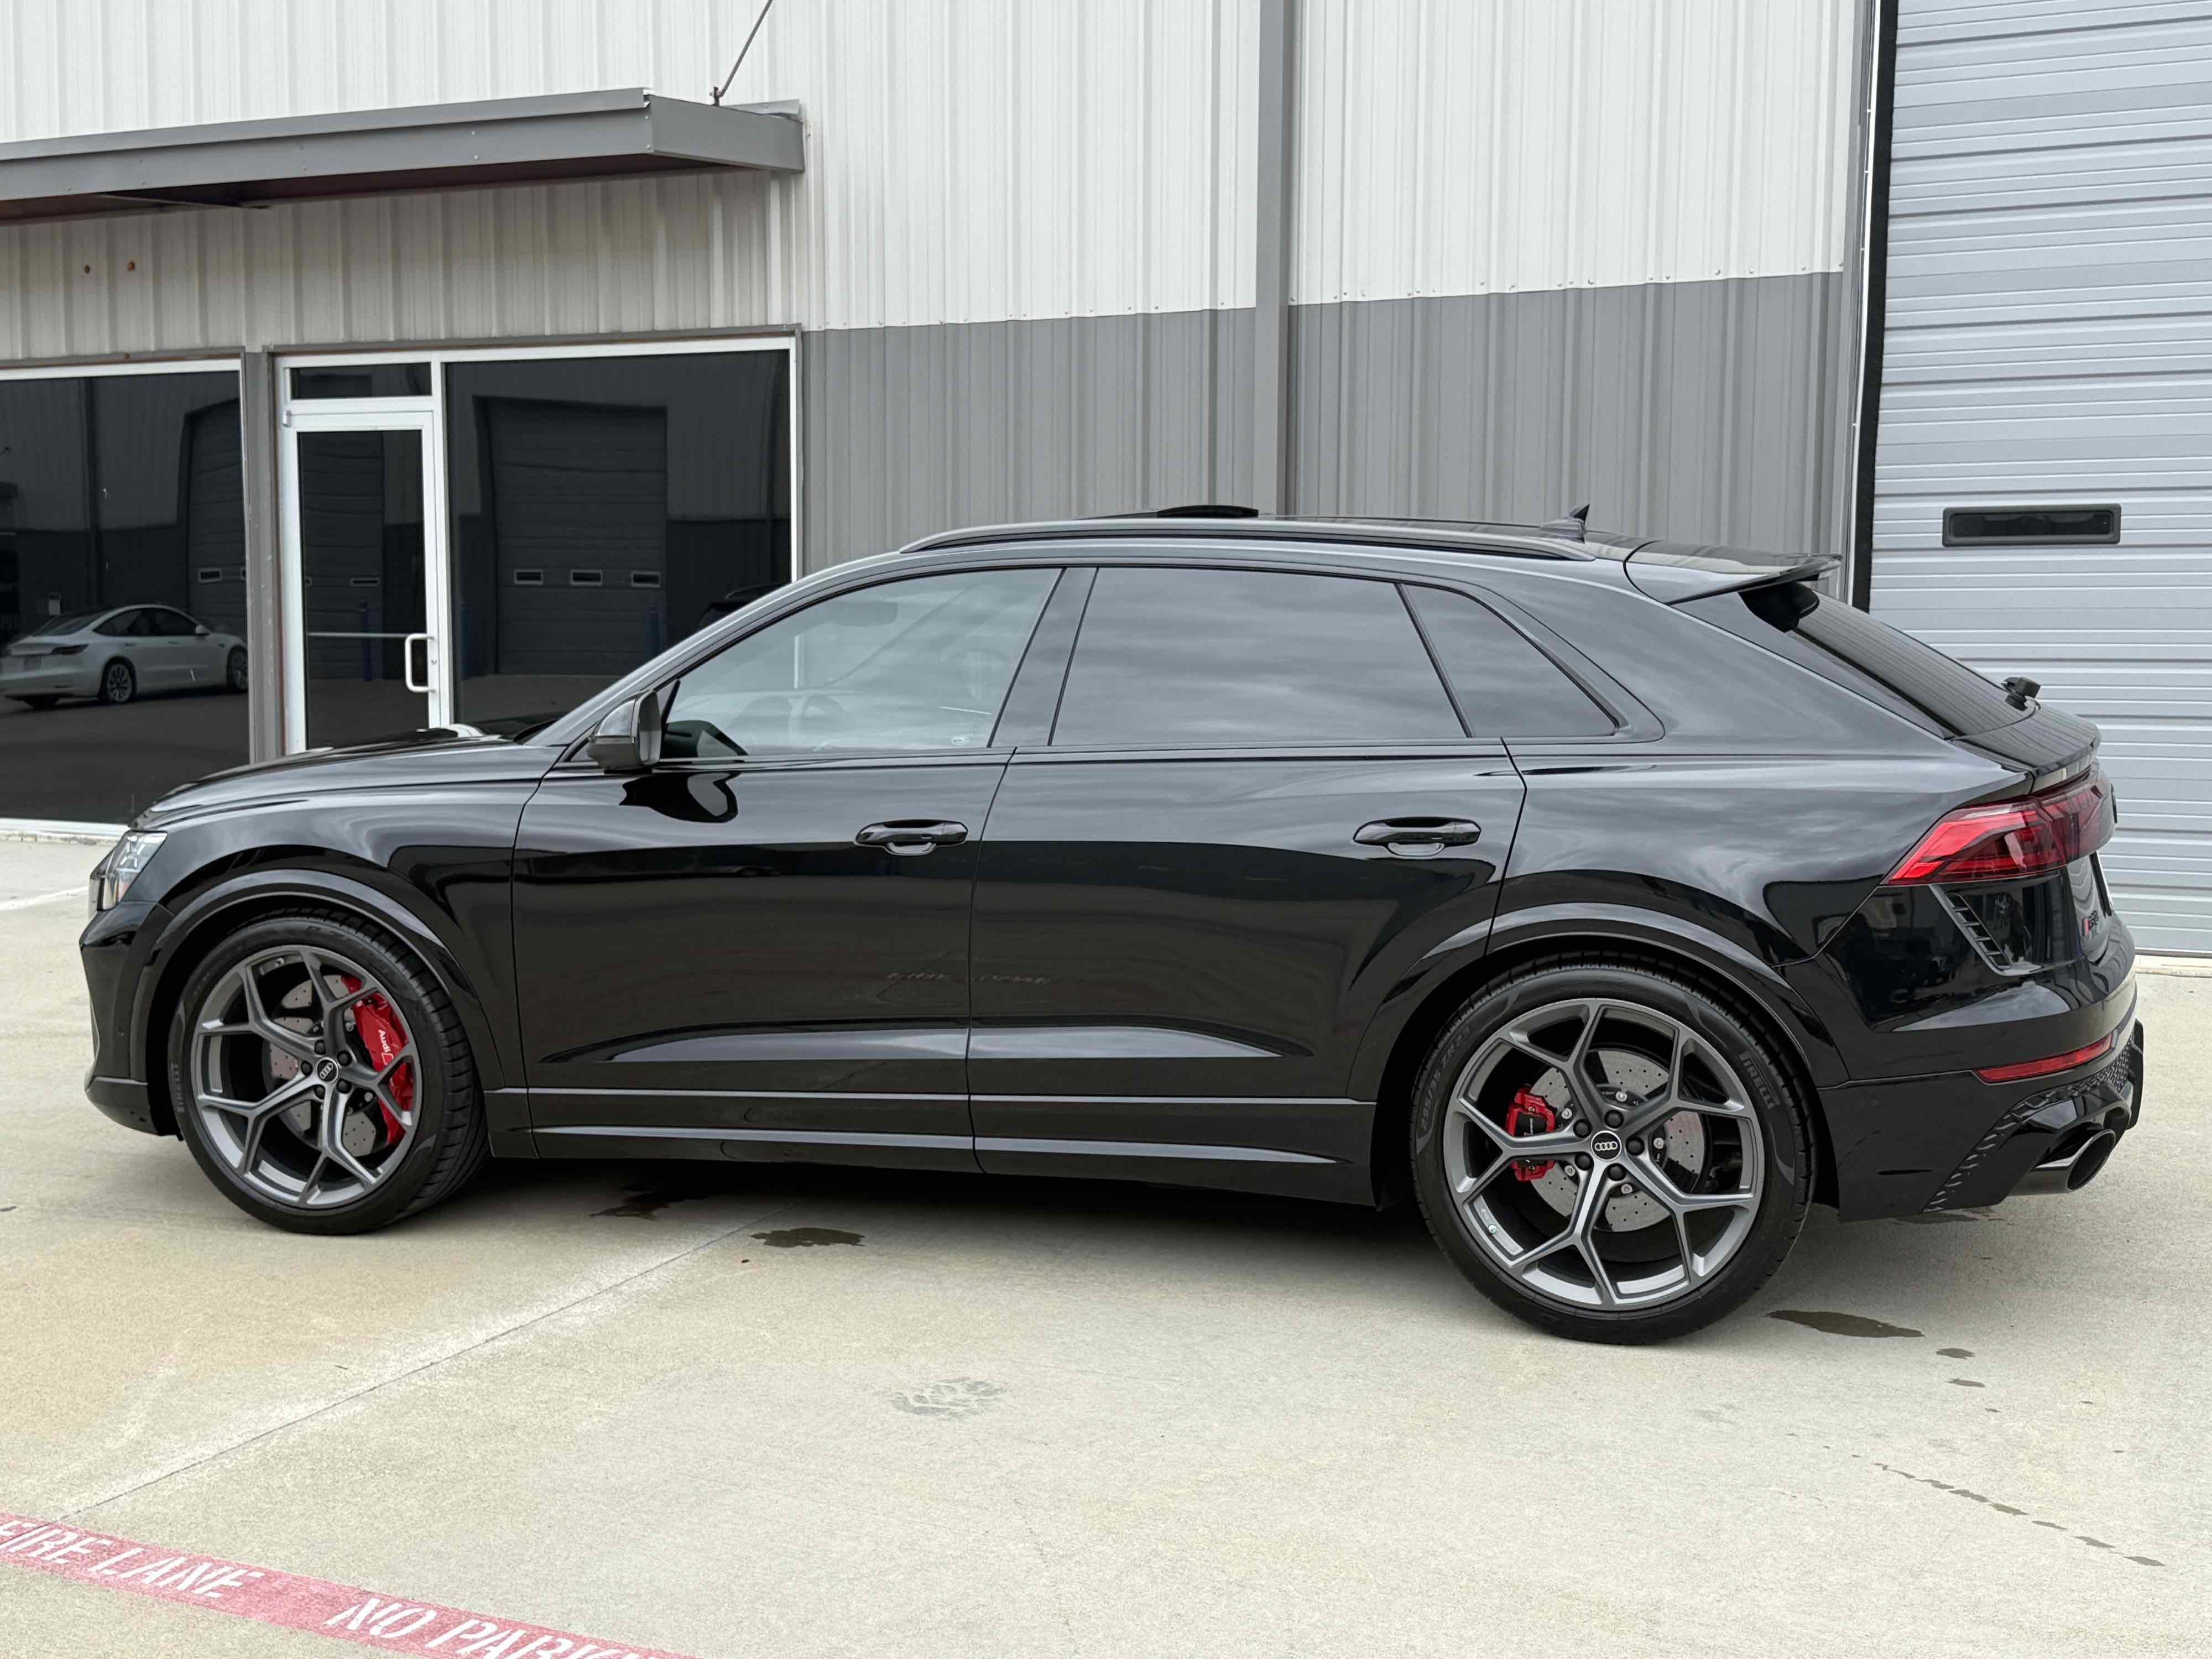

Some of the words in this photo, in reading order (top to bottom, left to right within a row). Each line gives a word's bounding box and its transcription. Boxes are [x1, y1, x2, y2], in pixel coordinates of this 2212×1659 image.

[378, 1029, 391, 1053] Audi
[1738, 1050, 1780, 1110] PIRELLI
[88, 1548, 265, 1598] LANE
[319, 1598, 436, 1638] NO
